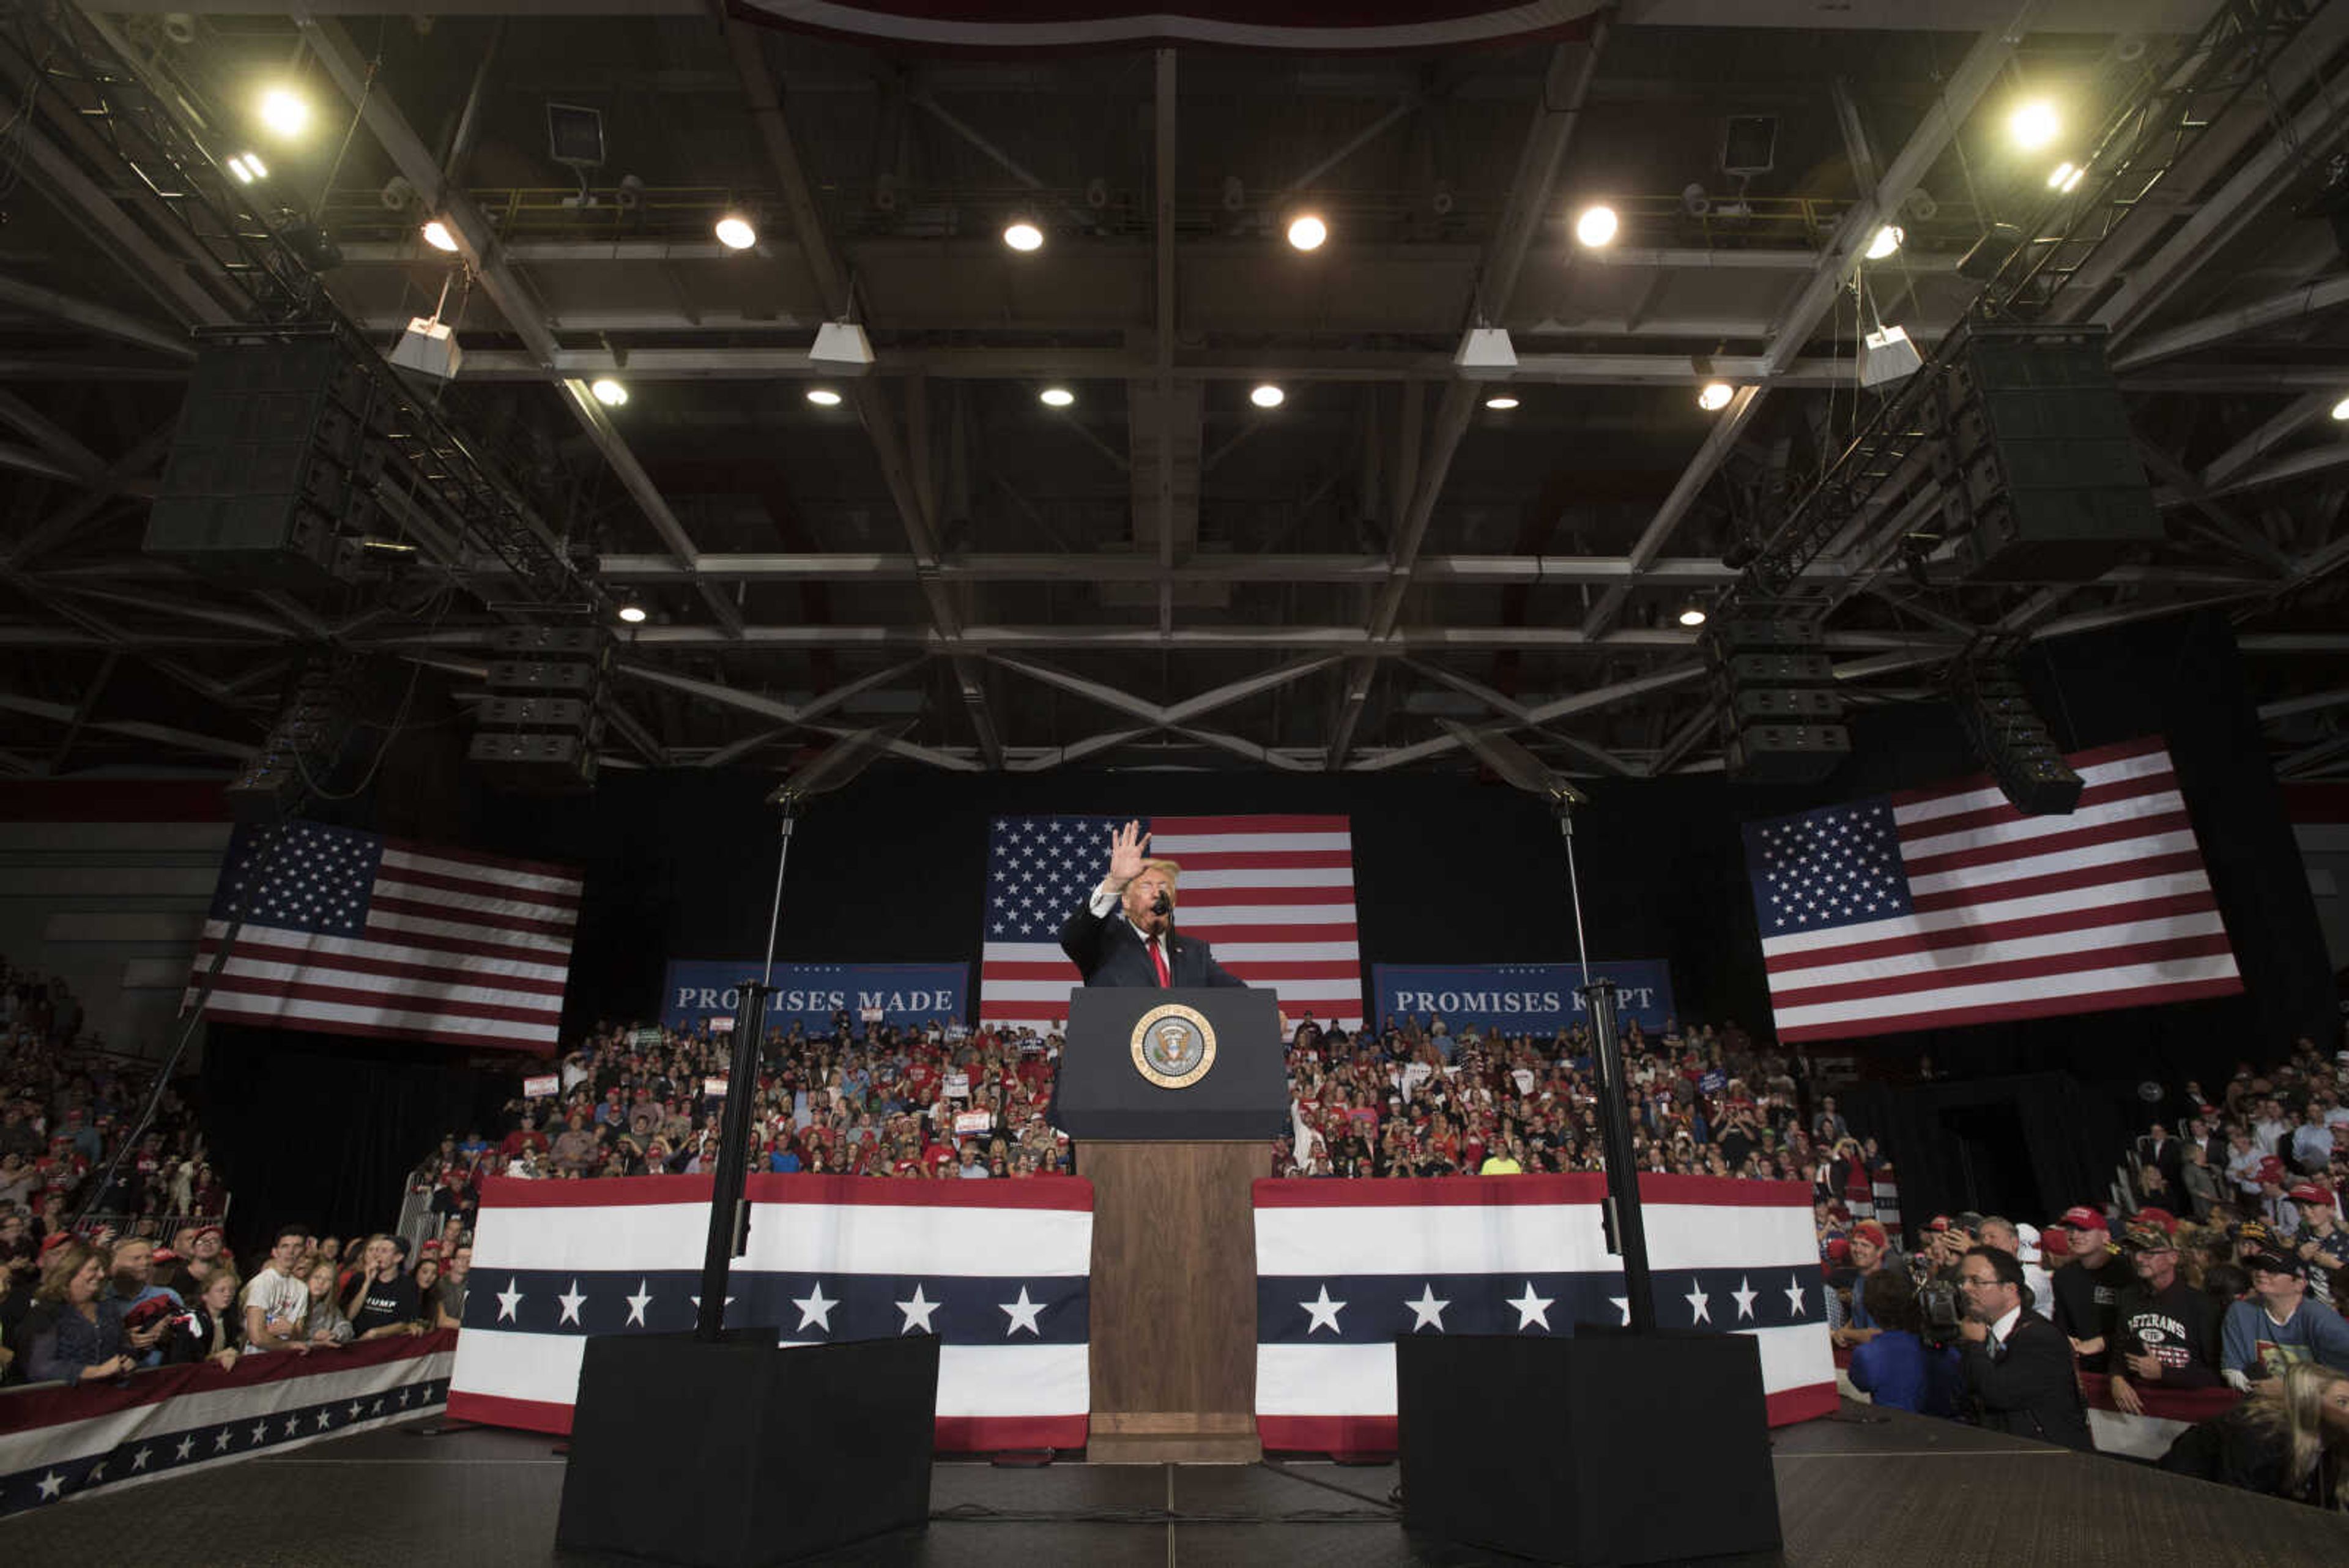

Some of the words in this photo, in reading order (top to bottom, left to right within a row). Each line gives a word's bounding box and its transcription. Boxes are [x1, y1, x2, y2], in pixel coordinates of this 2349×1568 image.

[676, 987, 845, 1011] PROISES
[857, 990, 952, 1011] MADE
[1395, 991, 1560, 1013] PROMISES
[1572, 988, 1653, 1011] KPT
